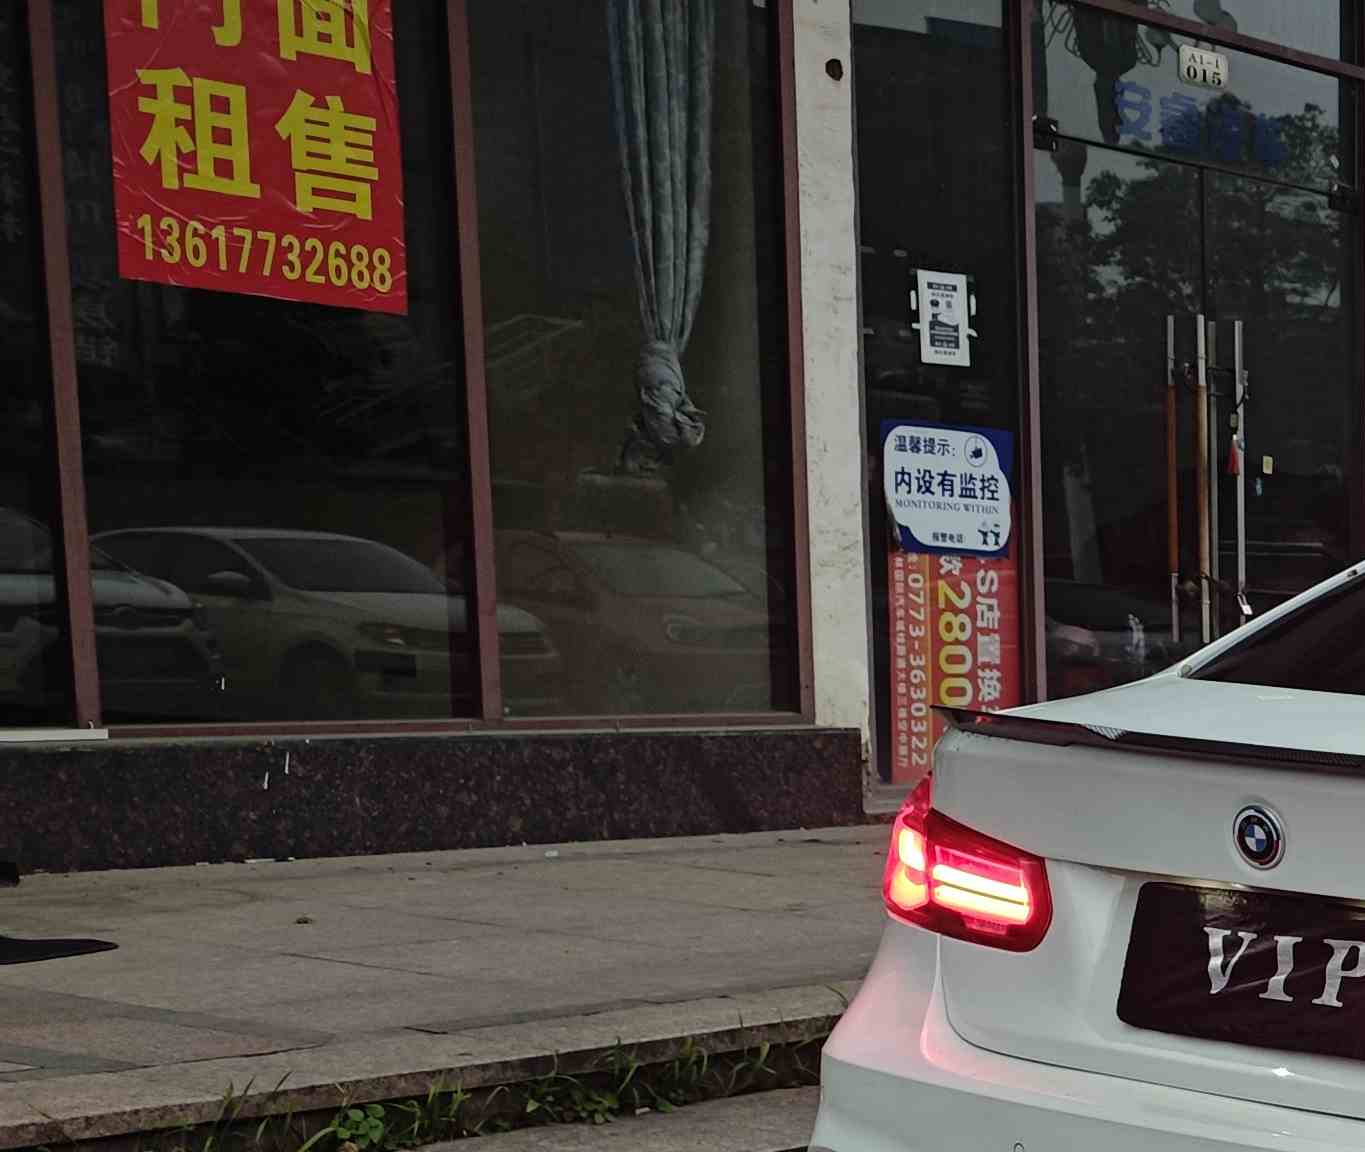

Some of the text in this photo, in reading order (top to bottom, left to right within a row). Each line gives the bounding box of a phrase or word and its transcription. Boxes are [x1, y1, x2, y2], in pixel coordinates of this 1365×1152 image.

[1186, 65, 1222, 86] 015
[136, 67, 380, 221] 租售
[136, 213, 393, 294] 13617732688
[894, 466, 1000, 502] 内设有监控
[895, 498, 1001, 515] MONITORING WITHIN
